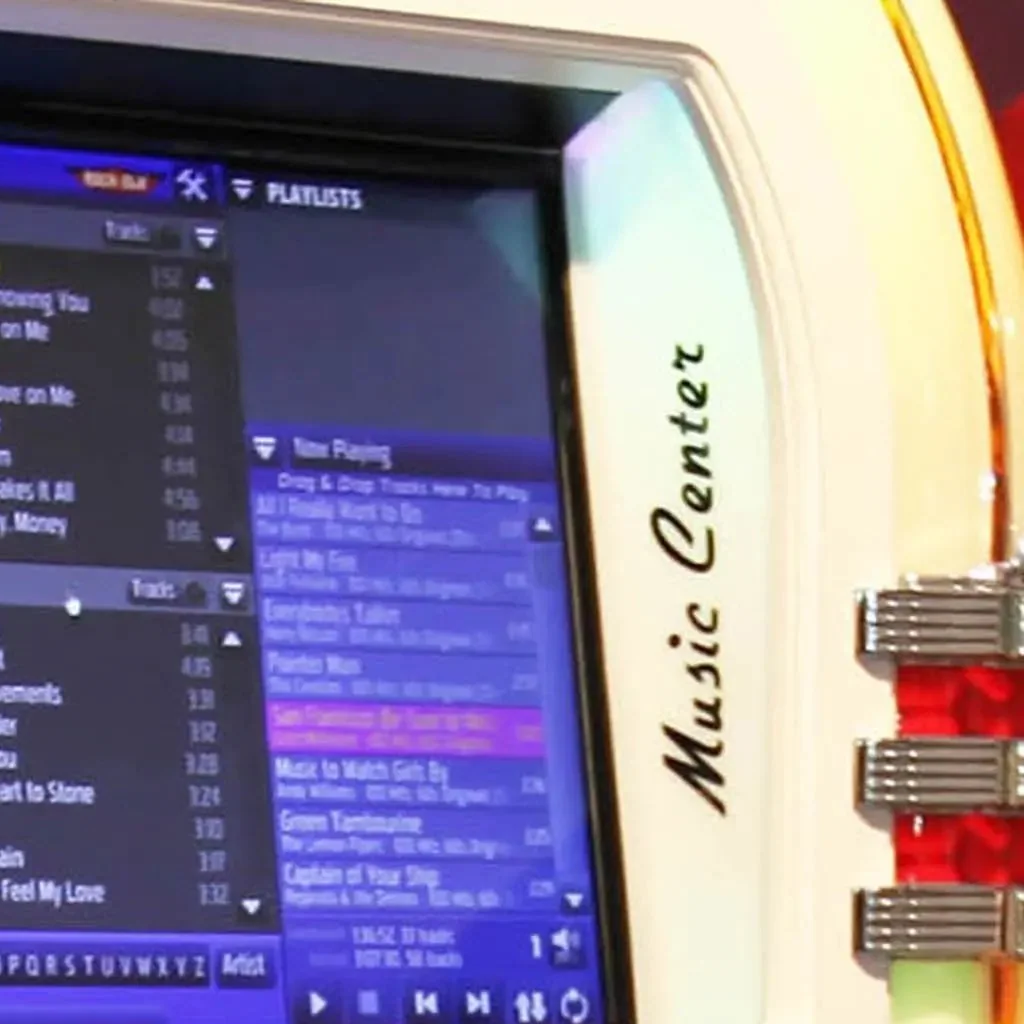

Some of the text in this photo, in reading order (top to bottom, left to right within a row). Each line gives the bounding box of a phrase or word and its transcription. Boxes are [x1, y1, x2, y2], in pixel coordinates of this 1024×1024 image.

[265, 182, 363, 210] PLAYLISTS
[57, 291, 91, 314] You
[0, 321, 23, 340] on
[25, 321, 51, 343] Me
[25, 385, 47, 405] on
[49, 385, 76, 408] Me
[52, 480, 76, 503] All
[13, 510, 69, 540] Money
[649, 343, 727, 818] Music Center
[26, 780, 45, 803] to
[48, 781, 96, 806] Stone
[0, 878, 36, 902] Feel
[38, 879, 63, 909] My
[64, 880, 107, 904] Love
[530, 933, 543, 960] 1
[222, 952, 266, 977] Artist
